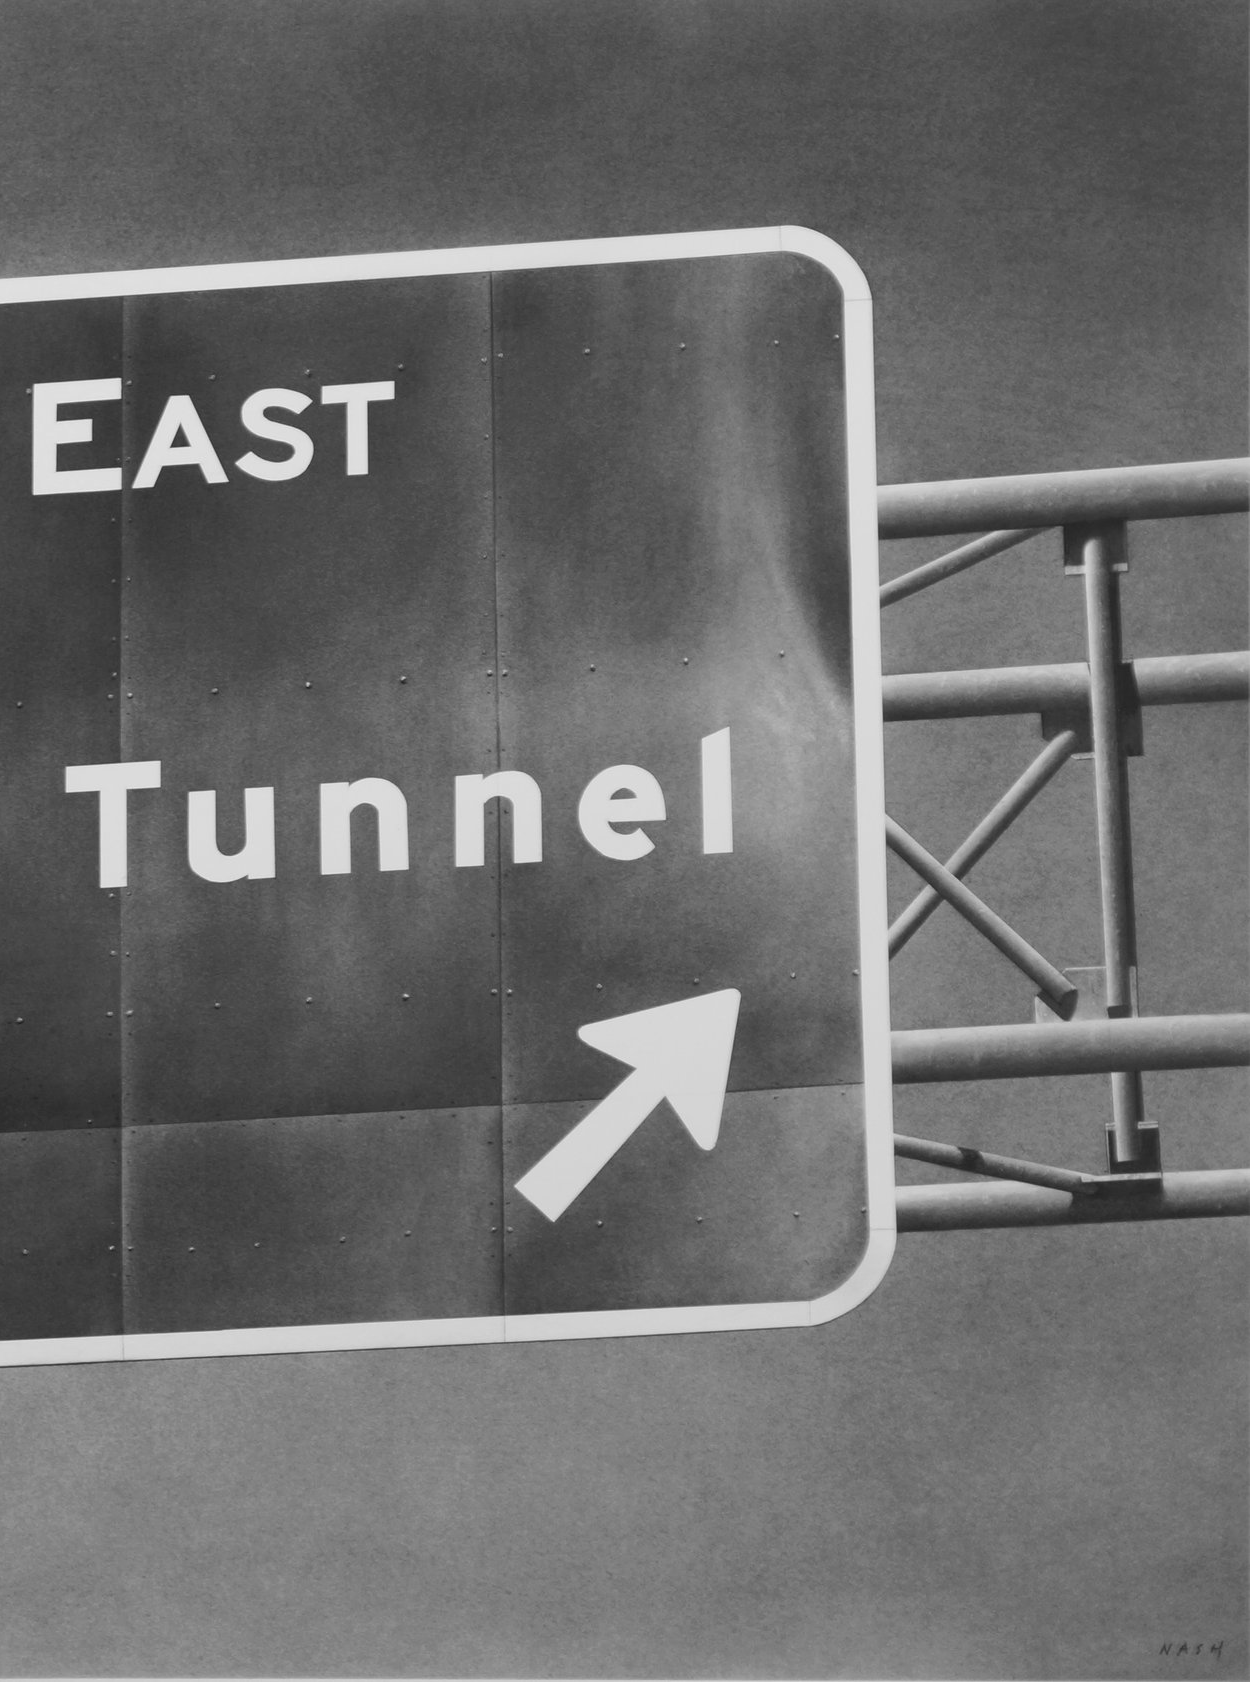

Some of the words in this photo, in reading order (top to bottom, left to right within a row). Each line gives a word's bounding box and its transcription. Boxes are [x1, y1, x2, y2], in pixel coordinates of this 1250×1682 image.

[31, 376, 396, 497] EAST
[64, 725, 734, 889] Tunnel
[1158, 1640, 1225, 1659] NASH
